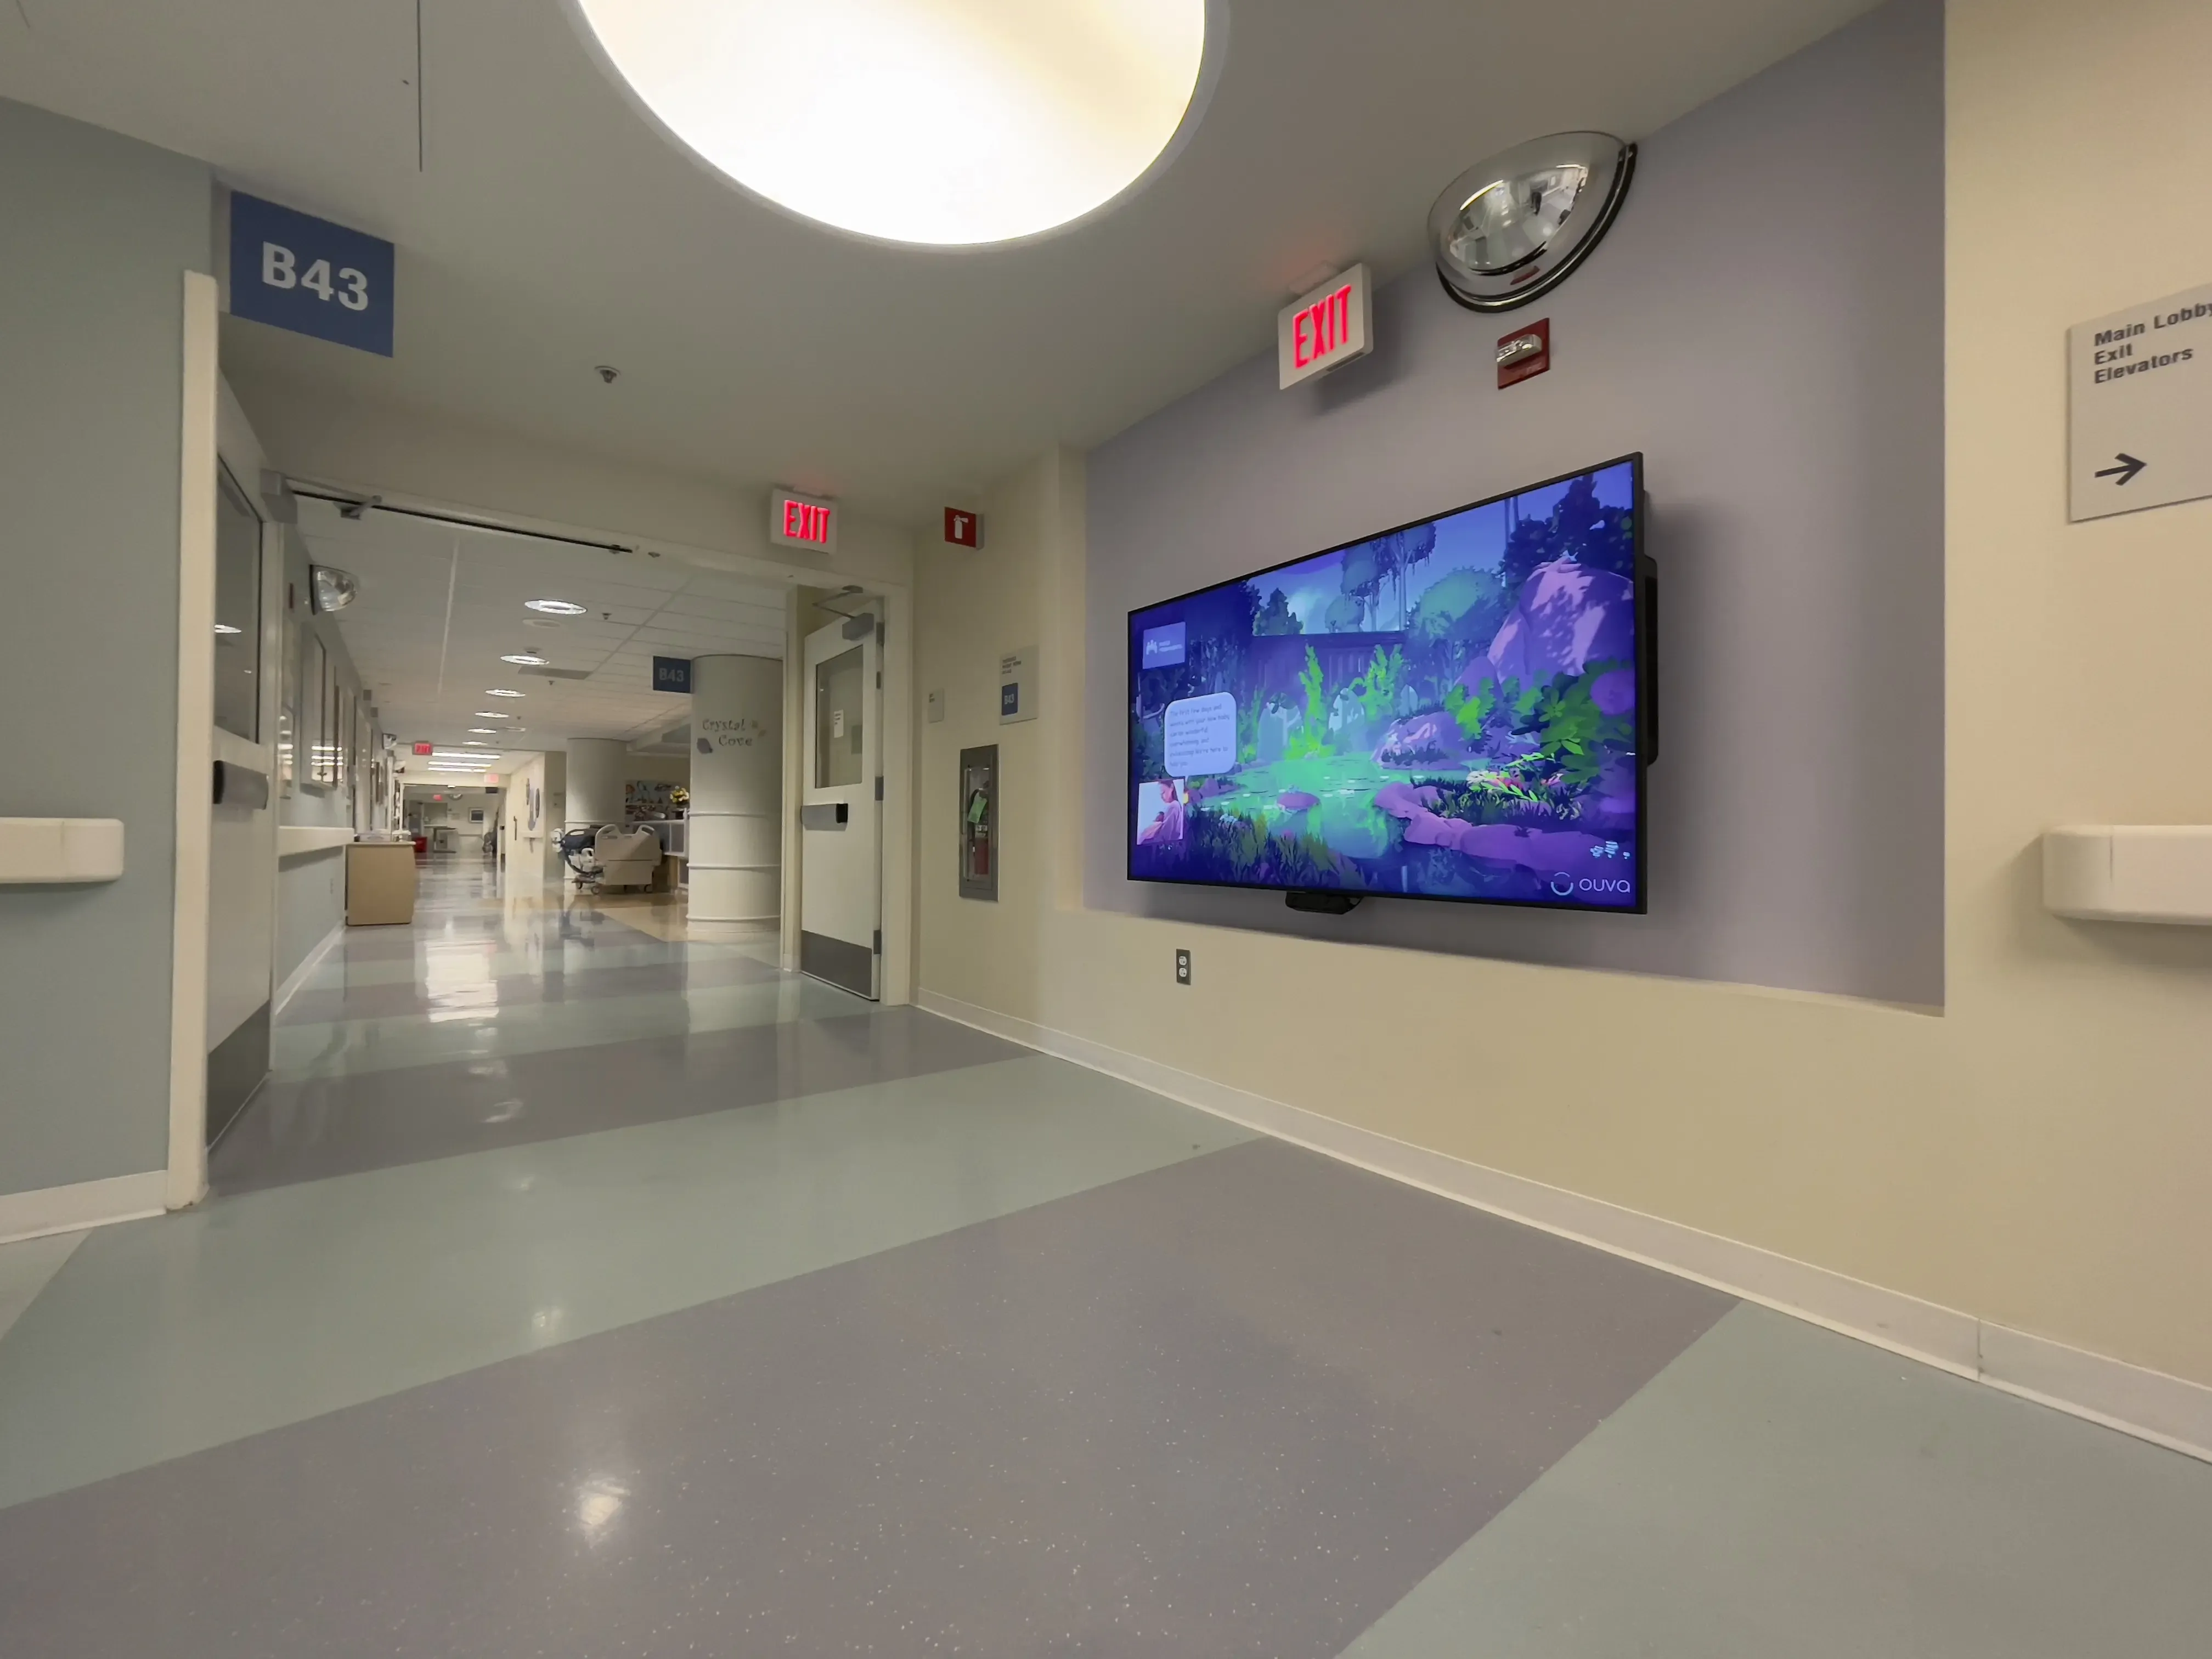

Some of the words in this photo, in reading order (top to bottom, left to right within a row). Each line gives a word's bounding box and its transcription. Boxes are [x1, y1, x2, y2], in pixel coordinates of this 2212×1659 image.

[262, 241, 369, 311] B43
[1293, 283, 1351, 369] EXIT
[2094, 323, 2146, 346] Main
[2094, 343, 2133, 365] Exit
[2094, 348, 2193, 383] Elevators
[783, 500, 830, 544] EXIT
[659, 668, 684, 682] B43
[702, 719, 746, 733] Crystal
[719, 735, 752, 747] Cove
[1579, 878, 1630, 893] ouva
